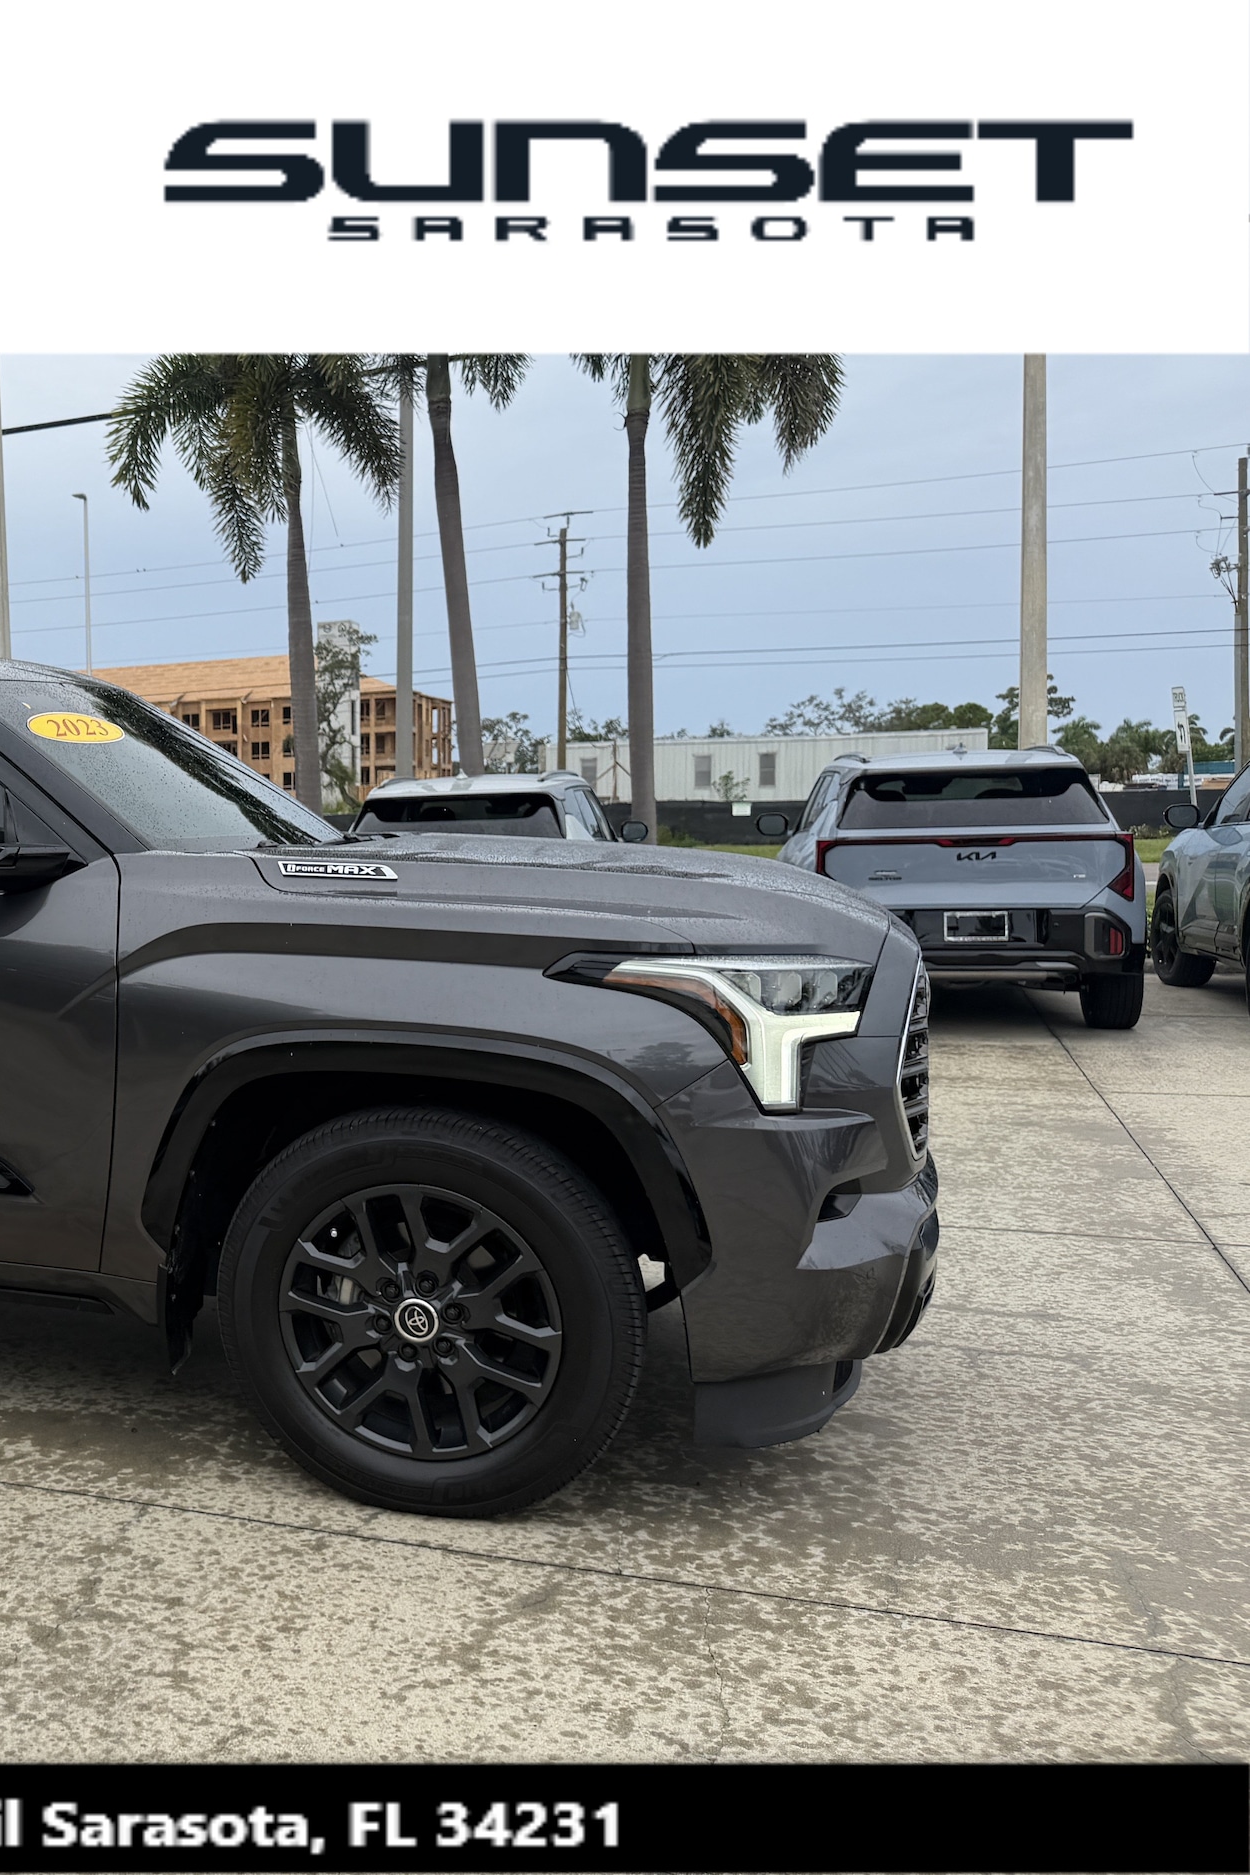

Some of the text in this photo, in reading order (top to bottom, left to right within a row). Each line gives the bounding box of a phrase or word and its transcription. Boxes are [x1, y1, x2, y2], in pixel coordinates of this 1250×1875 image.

[47, 718, 109, 737] 2023
[956, 851, 997, 862] KIA
[327, 865, 377, 876] MAX
